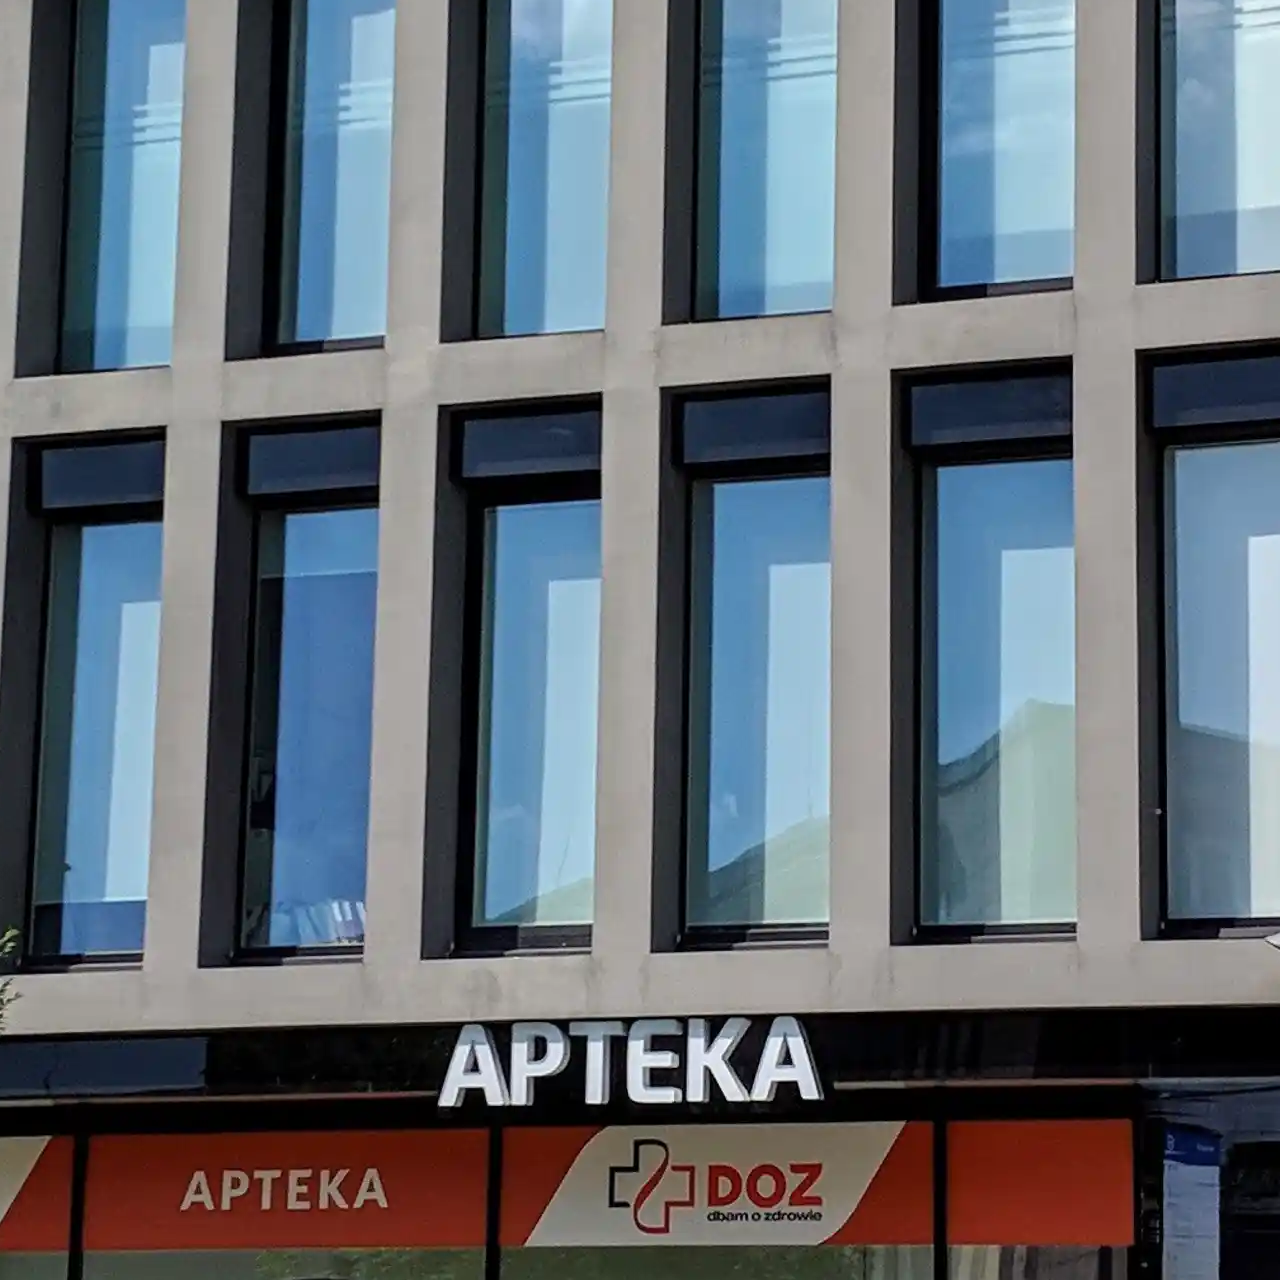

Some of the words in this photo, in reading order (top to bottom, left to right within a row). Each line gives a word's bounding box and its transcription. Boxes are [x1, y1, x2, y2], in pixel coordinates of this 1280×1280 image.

[438, 1016, 824, 1107] APTEKA
[180, 1166, 389, 1211] APTEKA
[708, 1163, 823, 1209] DOZ
[707, 1210, 748, 1222] dbam
[751, 1211, 761, 1222] o
[763, 1209, 822, 1222] zdrowie
